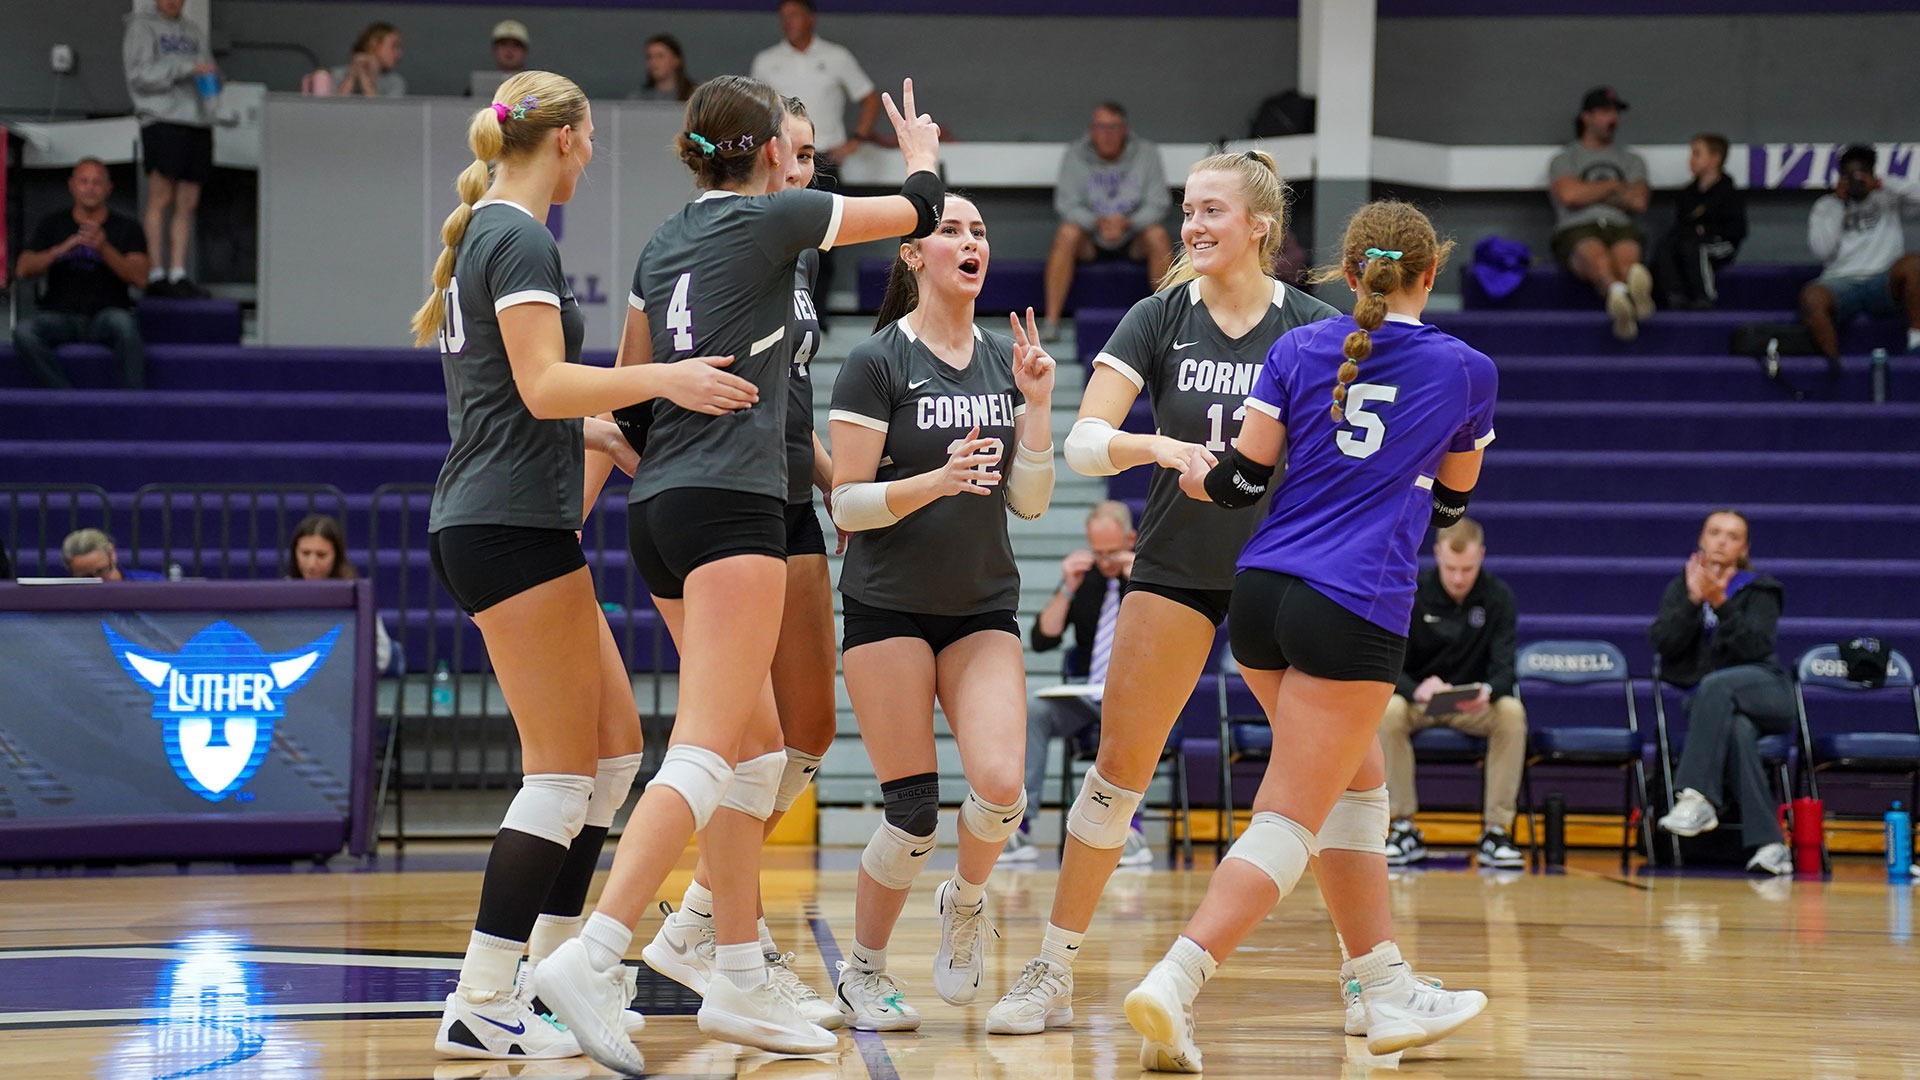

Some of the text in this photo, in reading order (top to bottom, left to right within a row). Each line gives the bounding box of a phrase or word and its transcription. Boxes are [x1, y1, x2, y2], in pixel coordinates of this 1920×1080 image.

[437, 276, 466, 354] 0
[666, 273, 693, 351] 4
[1336, 383, 1398, 459] 5
[168, 668, 276, 712] LUTHER
[1528, 653, 1614, 672] CORNELL
